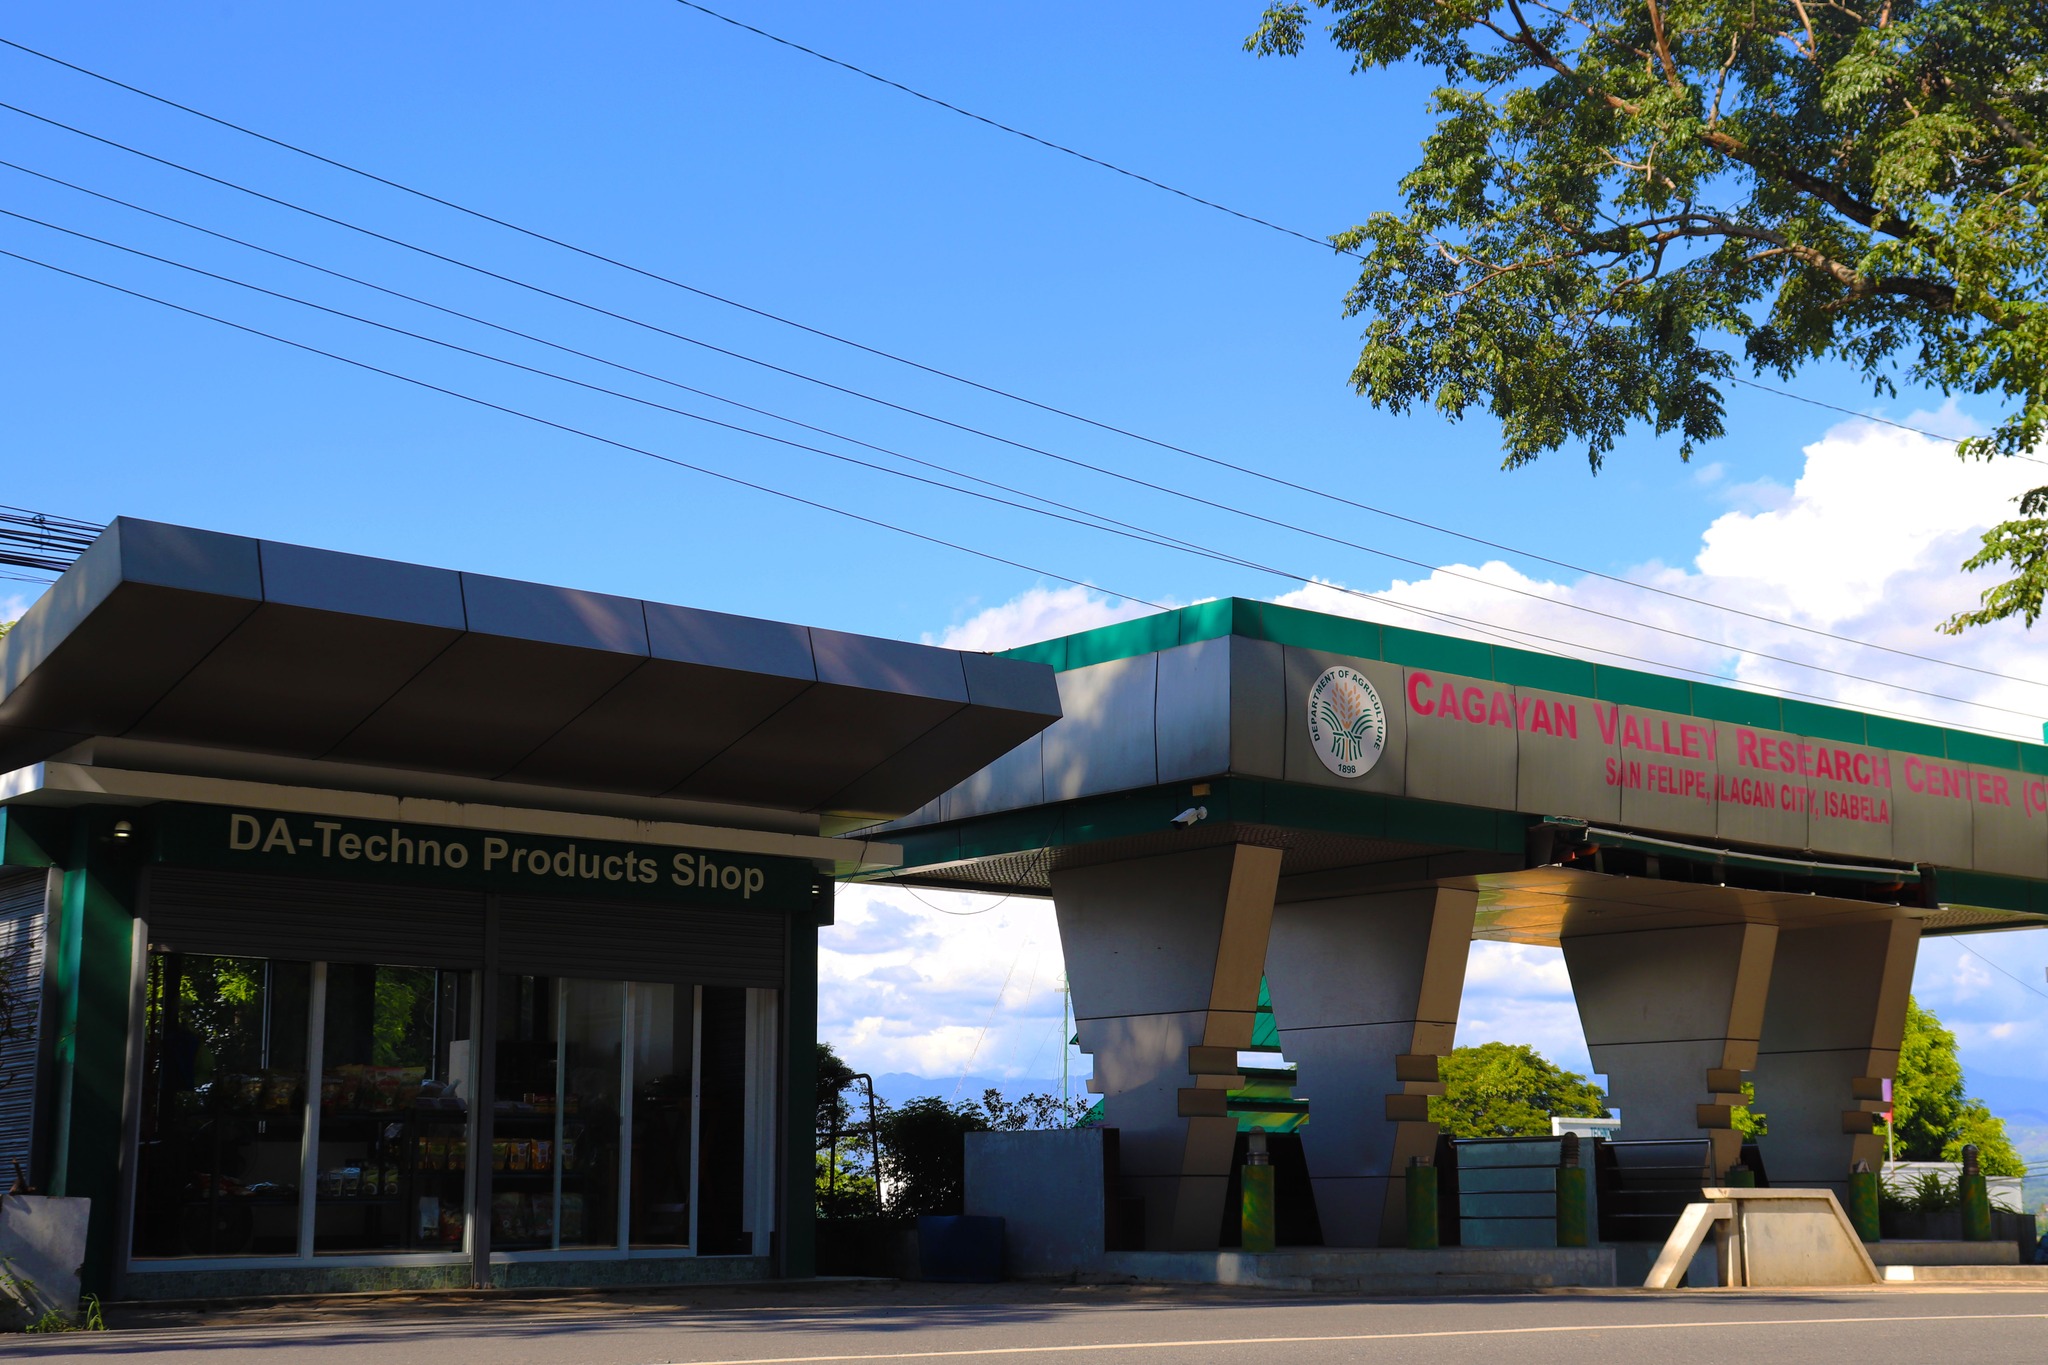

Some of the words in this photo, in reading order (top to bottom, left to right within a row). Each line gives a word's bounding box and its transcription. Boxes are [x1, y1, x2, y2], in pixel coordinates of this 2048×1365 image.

[1310, 671, 1335, 742] DEPARTMENT
[1338, 669, 1350, 679] OF
[1351, 673, 1384, 751] AGRICULTURE
[1407, 672, 1577, 740] CAGAYAN
[1593, 703, 1719, 761] VALLEY
[1736, 728, 1891, 789] RESEARCH
[1903, 756, 2011, 807] CENTER
[1337, 763, 1357, 774] 1898
[1605, 757, 1641, 789] SAN
[1647, 764, 1711, 805] FELIPE,
[1714, 774, 1776, 809] ILAGAN
[1780, 784, 1820, 820] CITY,
[1824, 791, 1890, 825] ISABELA
[229, 813, 469, 869] DA-Techno
[483, 837, 658, 884] Products
[671, 852, 764, 899] Shop
